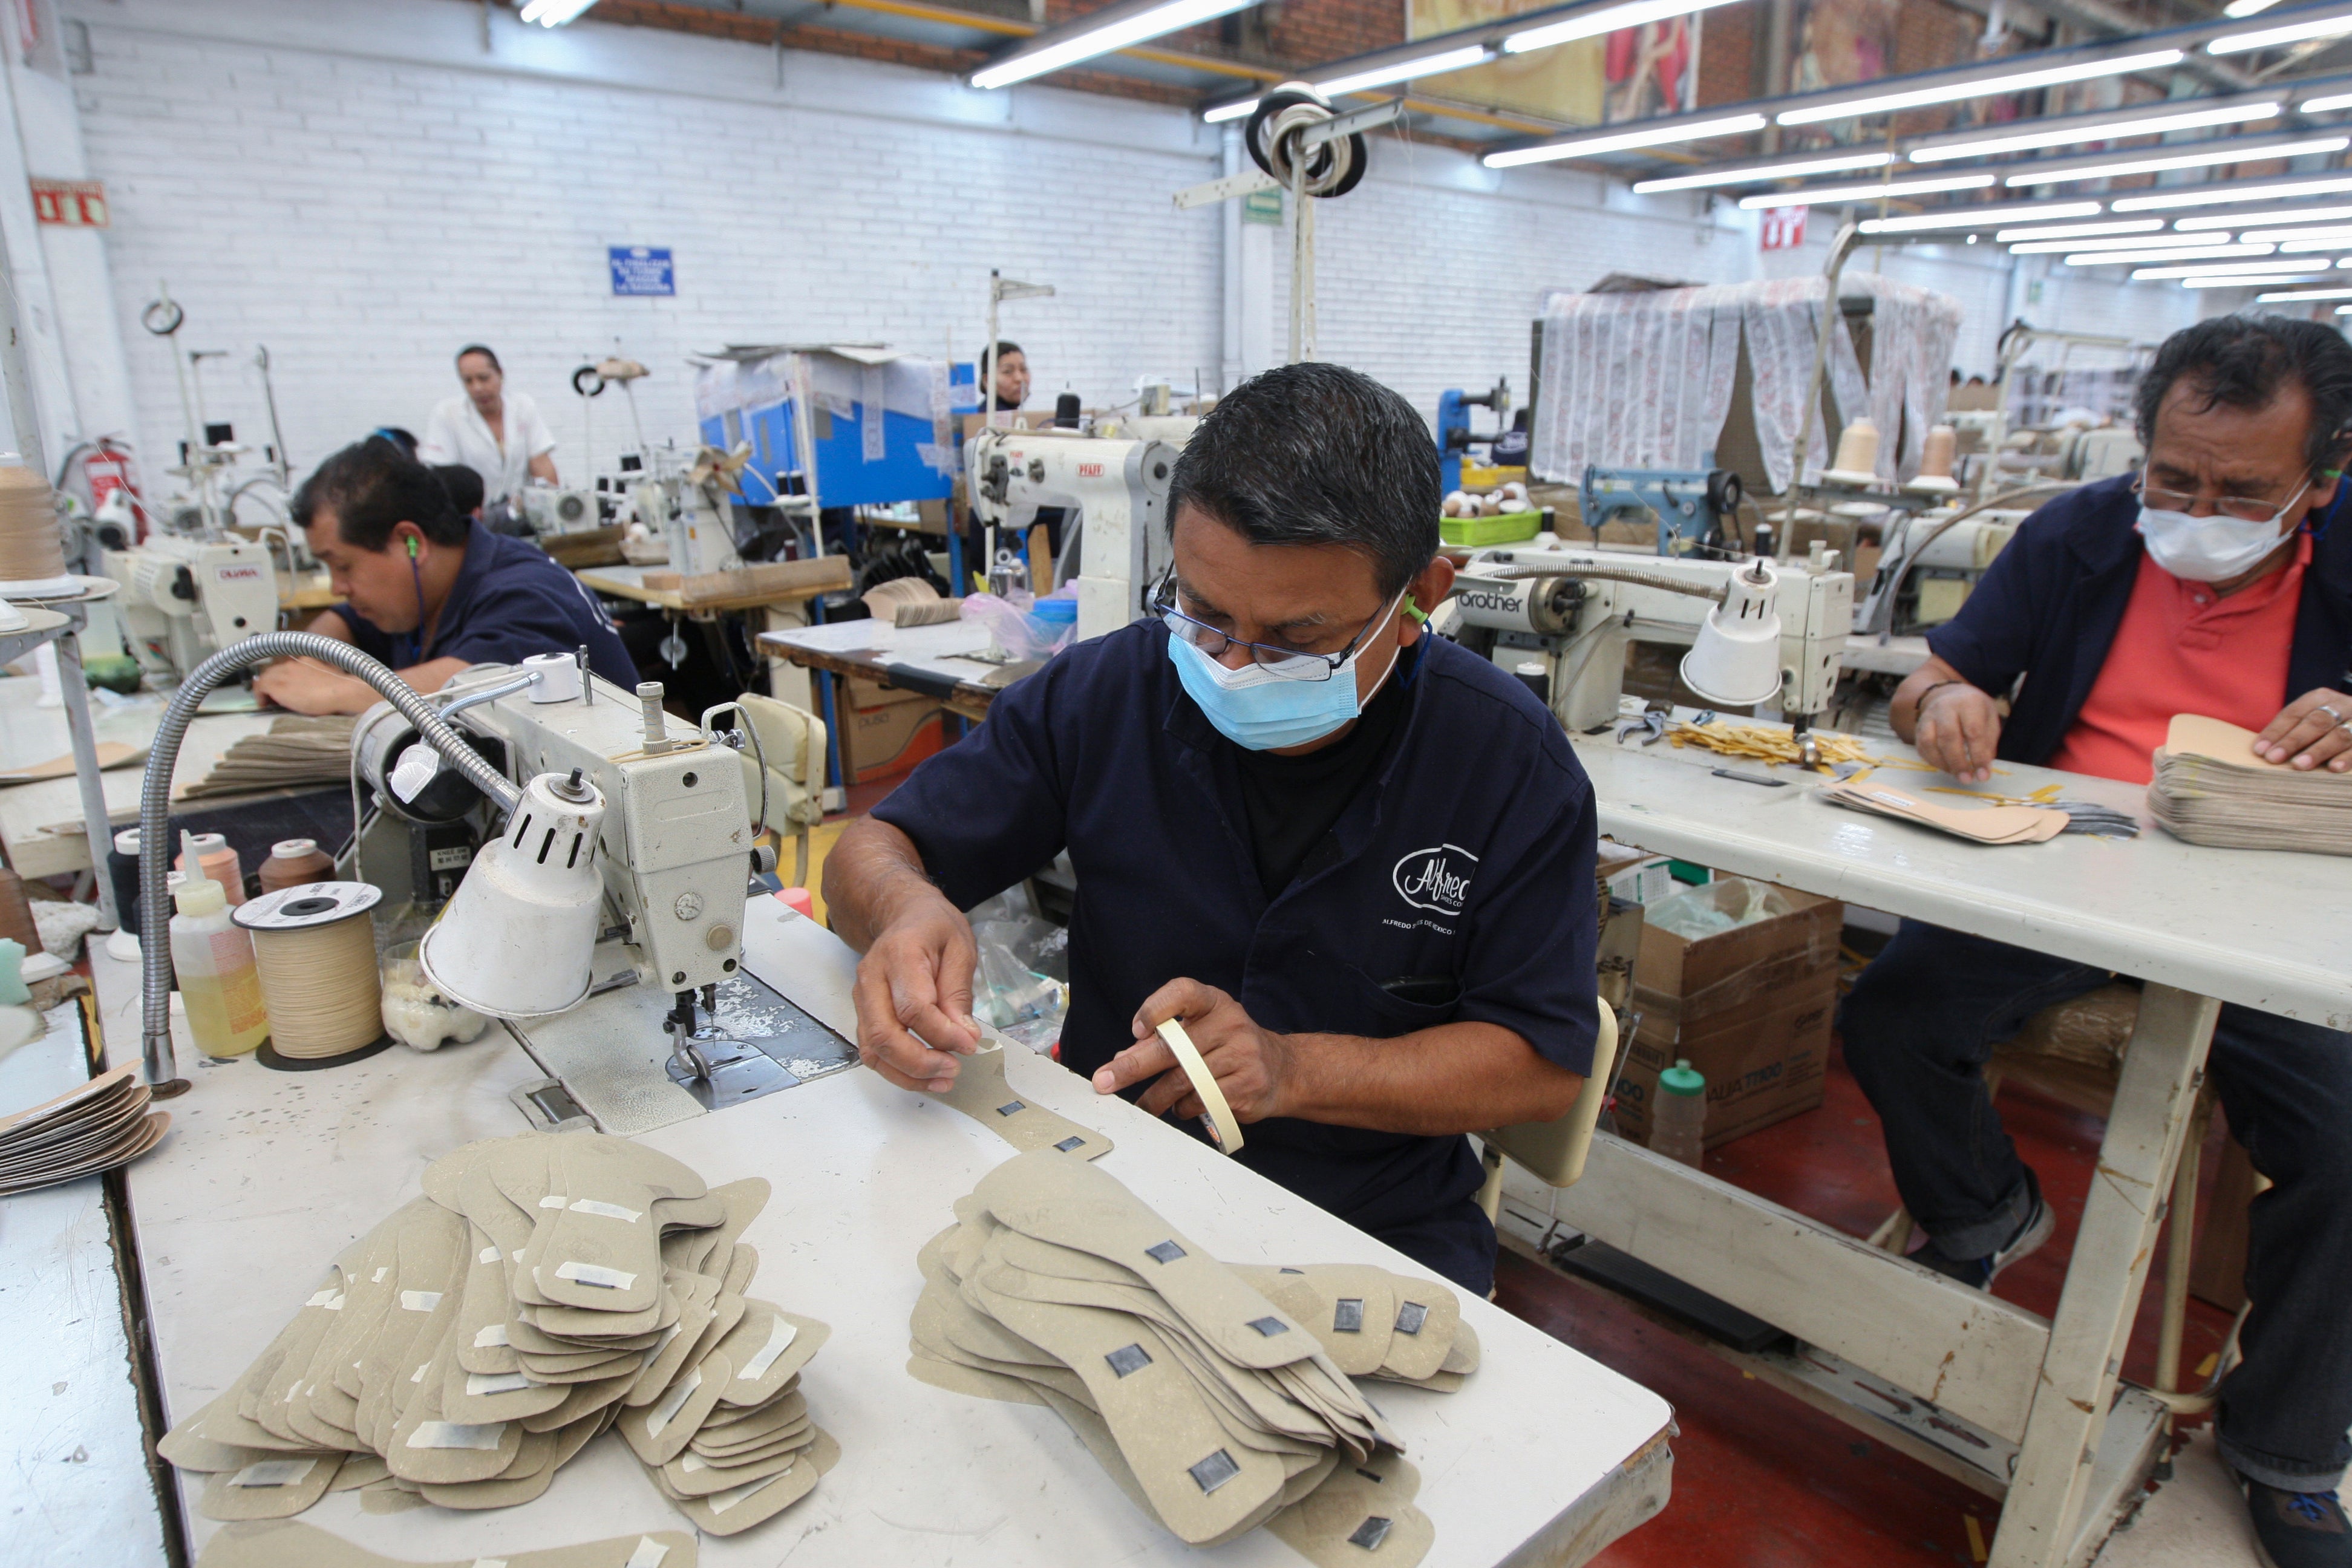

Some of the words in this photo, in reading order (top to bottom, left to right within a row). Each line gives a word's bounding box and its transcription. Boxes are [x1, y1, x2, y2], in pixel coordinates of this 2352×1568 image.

[1079, 464, 1102, 476] PFAFF
[1460, 592, 1523, 612] brother
[1382, 918, 1411, 930] ALFREDO
[1424, 920, 1432, 928] DE
